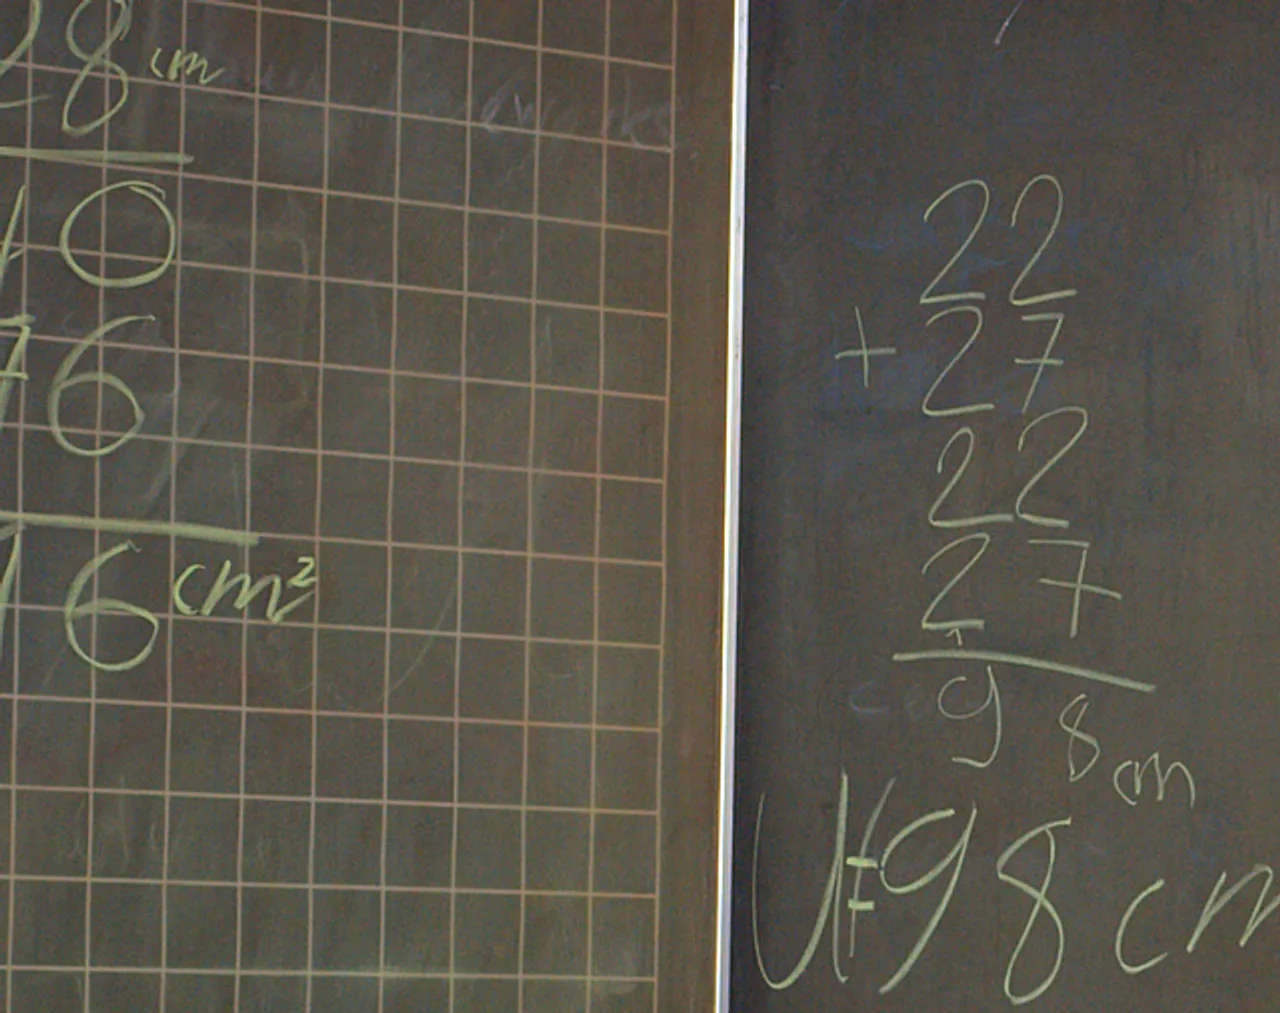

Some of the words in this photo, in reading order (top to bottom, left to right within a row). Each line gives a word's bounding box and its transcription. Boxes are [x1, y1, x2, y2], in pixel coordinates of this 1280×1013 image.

[151, 48, 225, 84] cm
[919, 173, 1077, 305] 22
[921, 305, 1064, 415] 27
[927, 405, 1088, 528] 22
[921, 532, 1122, 638] 27
